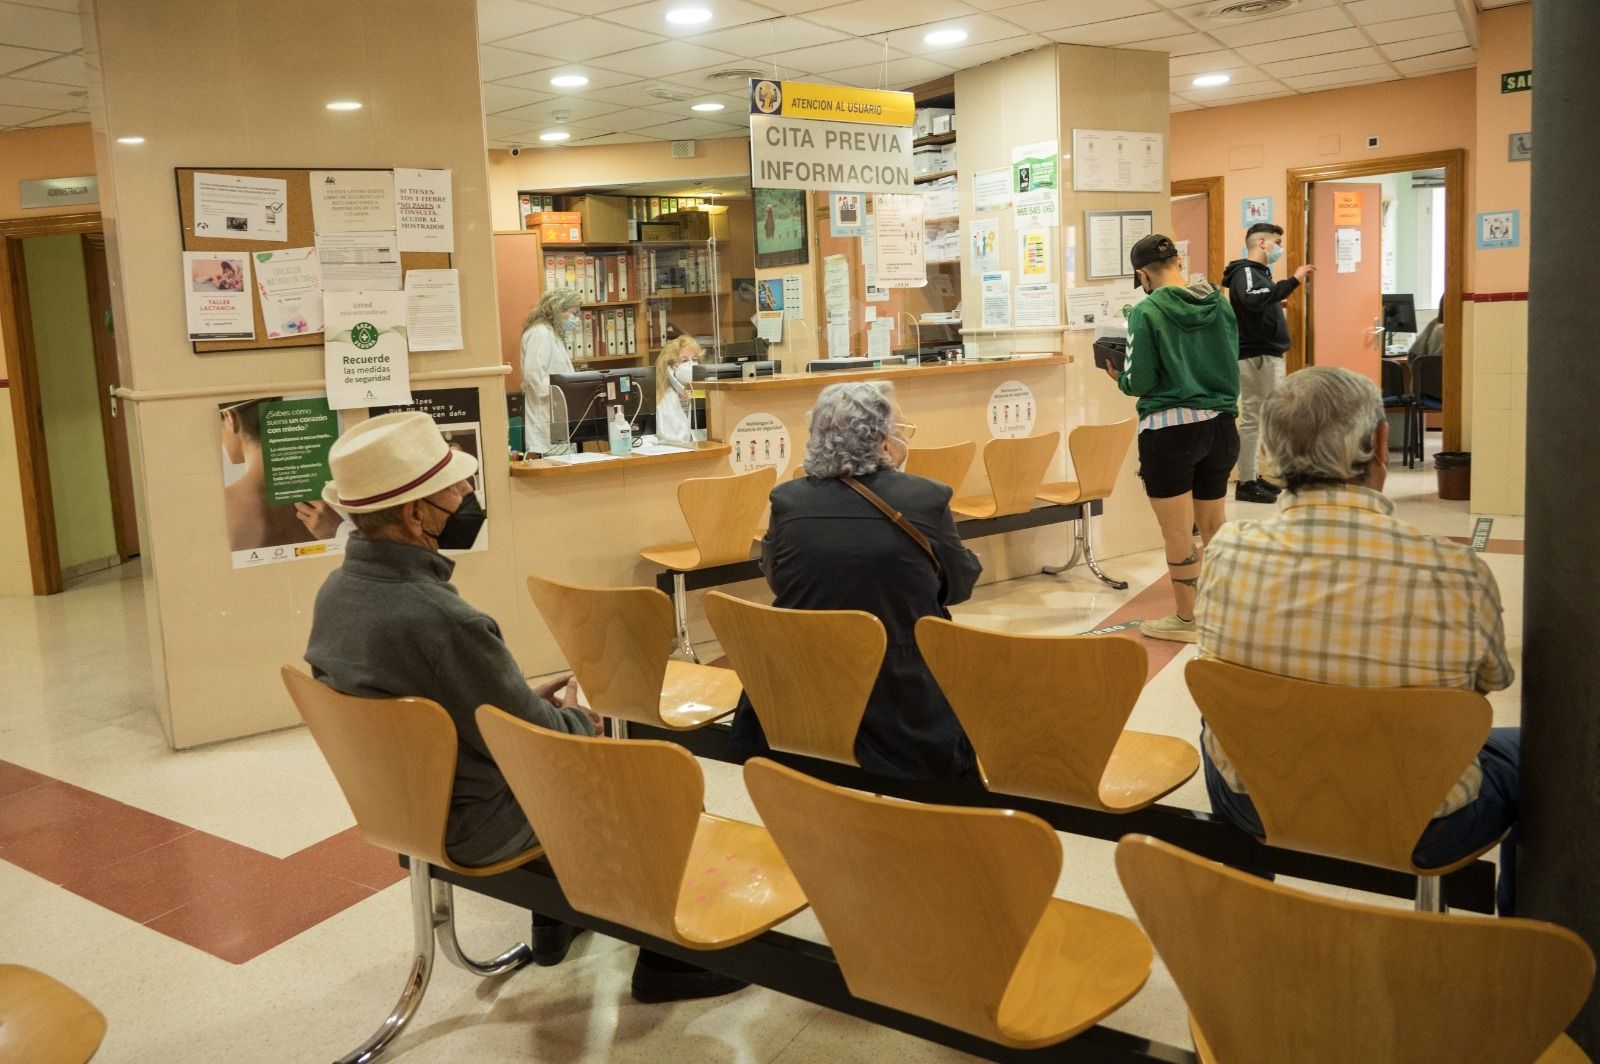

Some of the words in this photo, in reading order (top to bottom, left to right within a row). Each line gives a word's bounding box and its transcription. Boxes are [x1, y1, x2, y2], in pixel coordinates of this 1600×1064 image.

[791, 98, 832, 112] ATENCION
[835, 101, 845, 111] AL
[847, 102, 882, 115] USUARIO
[766, 126, 815, 148] CITA
[825, 130, 902, 153] PREVIA
[760, 160, 909, 185] INFORMACION
[343, 354, 390, 365] Recuerde
[343, 367, 355, 375] las
[356, 365, 391, 374] medidas
[355, 375, 391, 385] seguridad
[413, 398, 432, 406] lpes
[291, 408, 312, 416] cómo
[449, 409, 467, 417] daño
[266, 419, 289, 427] suena
[299, 415, 328, 423] corazón
